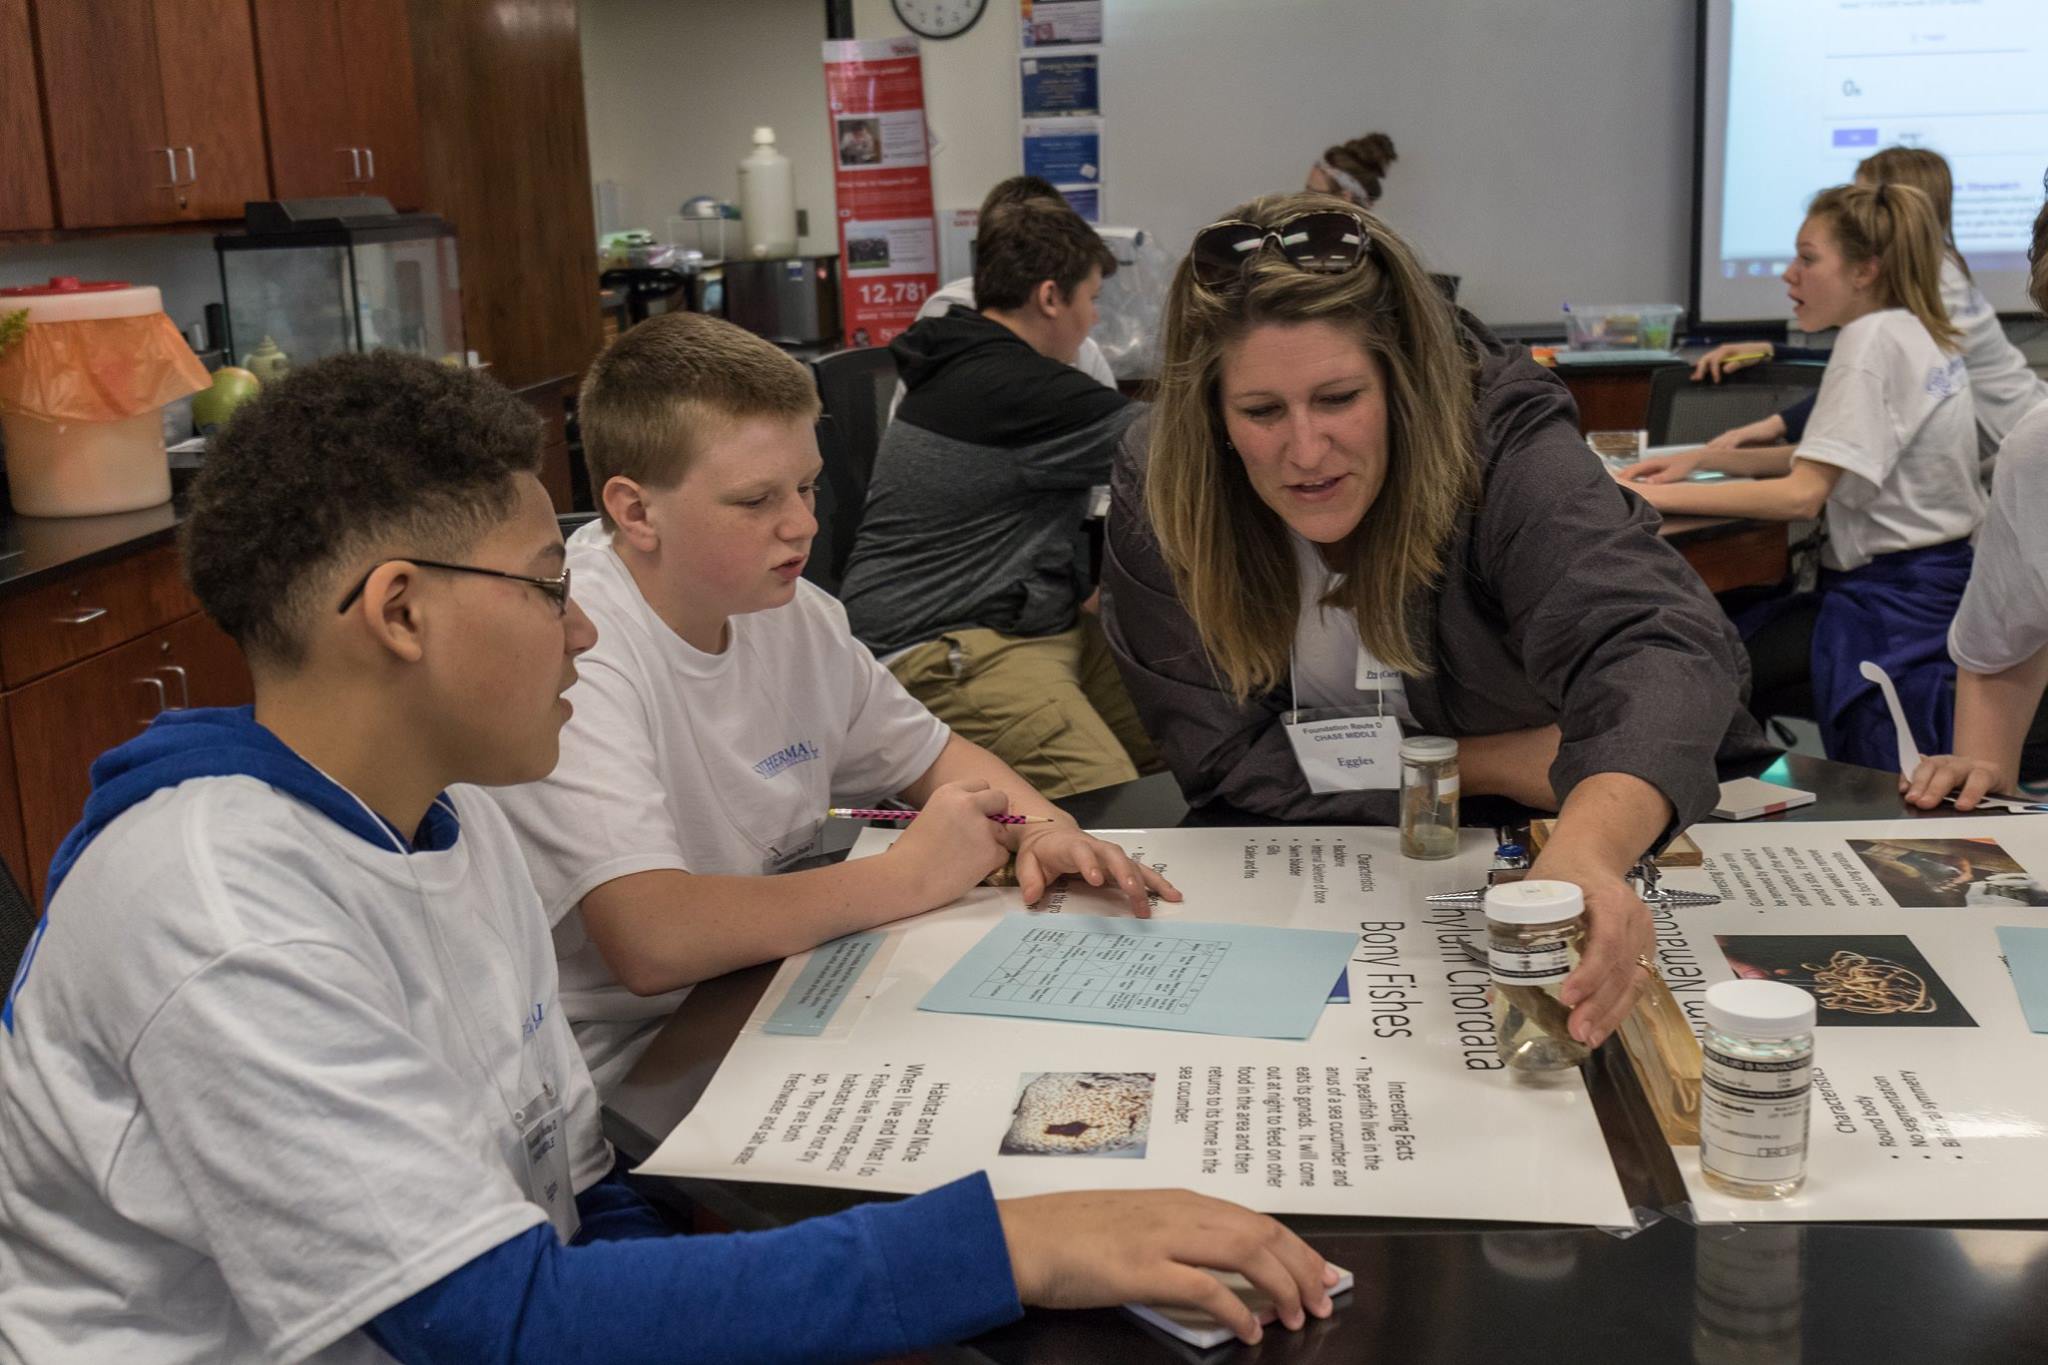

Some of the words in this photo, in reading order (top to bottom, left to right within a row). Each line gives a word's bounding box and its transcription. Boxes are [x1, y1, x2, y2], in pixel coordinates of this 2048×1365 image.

[859, 281, 928, 306] 12,781
[1302, 722, 1348, 736] Foundation
[1350, 721, 1374, 731] Route
[1314, 732, 1343, 743] CHASE
[1345, 730, 1377, 740] MIDDLE
[1244, 845, 1258, 859] Scales
[1267, 845, 1280, 855] Gills
[1333, 845, 1347, 867] Backbone
[1244, 860, 1257, 869] and
[1289, 859, 1303, 876] bladder
[1357, 854, 1377, 892] Characteristics
[1709, 872, 1736, 900] Interesting
[1733, 872, 1751, 888] worms
[1758, 878, 1782, 899] removed
[1781, 875, 1804, 892] portion
[1314, 890, 1326, 903] bone
[1744, 889, 1765, 907] Guinea
[1790, 893, 1813, 907] small
[1810, 889, 1836, 907] around
[1832, 889, 1860, 907] several
[1867, 898, 1883, 907] the
[1353, 922, 1405, 966] Bony
[1366, 974, 1422, 1038] Fishes
[810, 1074, 829, 1086] up.
[896, 1064, 925, 1093] Where
[1178, 1066, 1194, 1080] sea
[1207, 1066, 1225, 1095] returns
[1237, 1066, 1255, 1084] food
[1266, 1066, 1283, 1080] out
[1296, 1067, 1312, 1083] eats
[1326, 1067, 1340, 1085] anus
[1355, 1067, 1374, 1081] The
[770, 1073, 806, 1114] freshwater
[832, 1074, 862, 1105] habitats
[865, 1074, 891, 1098] Fishes
[1237, 1086, 1255, 1094] in
[1266, 1082, 1283, 1090] at
[1297, 1085, 1314, 1095] its
[1328, 1088, 1346, 1097] of
[1898, 1070, 1938, 1110] symmetry
[797, 1090, 826, 1110] They
[858, 1100, 880, 1114] live
[921, 1083, 950, 1116] Habitat
[1174, 1081, 1195, 1124] cucumber.
[1206, 1097, 1224, 1106] to
[1237, 1096, 1255, 1111] the
[1263, 1092, 1286, 1113] night
[1353, 1083, 1379, 1119] pearlfish
[1387, 1081, 1412, 1132] Interesting
[1811, 1067, 1857, 1134] Characteristics
[1853, 1095, 1880, 1116] body
[1873, 1076, 1921, 1132] segmentation
[792, 1111, 811, 1123] are
[823, 1107, 847, 1123] that
[887, 1101, 912, 1117] live
[1205, 1108, 1223, 1118] its
[1293, 1097, 1317, 1130] gonads.
[1328, 1105, 1344, 1119] sea
[757, 1116, 782, 1130] and
[879, 1119, 901, 1135] and
[914, 1119, 934, 1135] and
[1236, 1112, 1251, 1132] area
[1266, 1115, 1283, 1125] to
[748, 1131, 769, 1144] salt
[781, 1125, 808, 1143] both
[817, 1125, 837, 1135] do
[843, 1125, 867, 1144] most
[1204, 1120, 1224, 1146] home
[1266, 1127, 1286, 1147] feed
[1361, 1121, 1380, 1141] lives
[1863, 1119, 1898, 1147] Round
[808, 1137, 828, 1149] not
[866, 1137, 896, 1160] What
[901, 1137, 930, 1162] Niche
[1236, 1133, 1254, 1151] and
[1329, 1122, 1352, 1167] cucumber
[1363, 1144, 1381, 1152] in
[1394, 1134, 1416, 1161] Facts
[1907, 1135, 1930, 1147] No
[795, 1151, 821, 1163] dry
[1203, 1148, 1222, 1156] in
[1267, 1149, 1282, 1161] on
[1299, 1144, 1319, 1160] will
[857, 1167, 879, 1176] do
[1202, 1159, 1222, 1174] the
[1235, 1153, 1253, 1174] then
[1364, 1155, 1383, 1171] the
[1266, 1163, 1287, 1188] other
[1300, 1162, 1316, 1186] come
[1332, 1170, 1353, 1186] and
